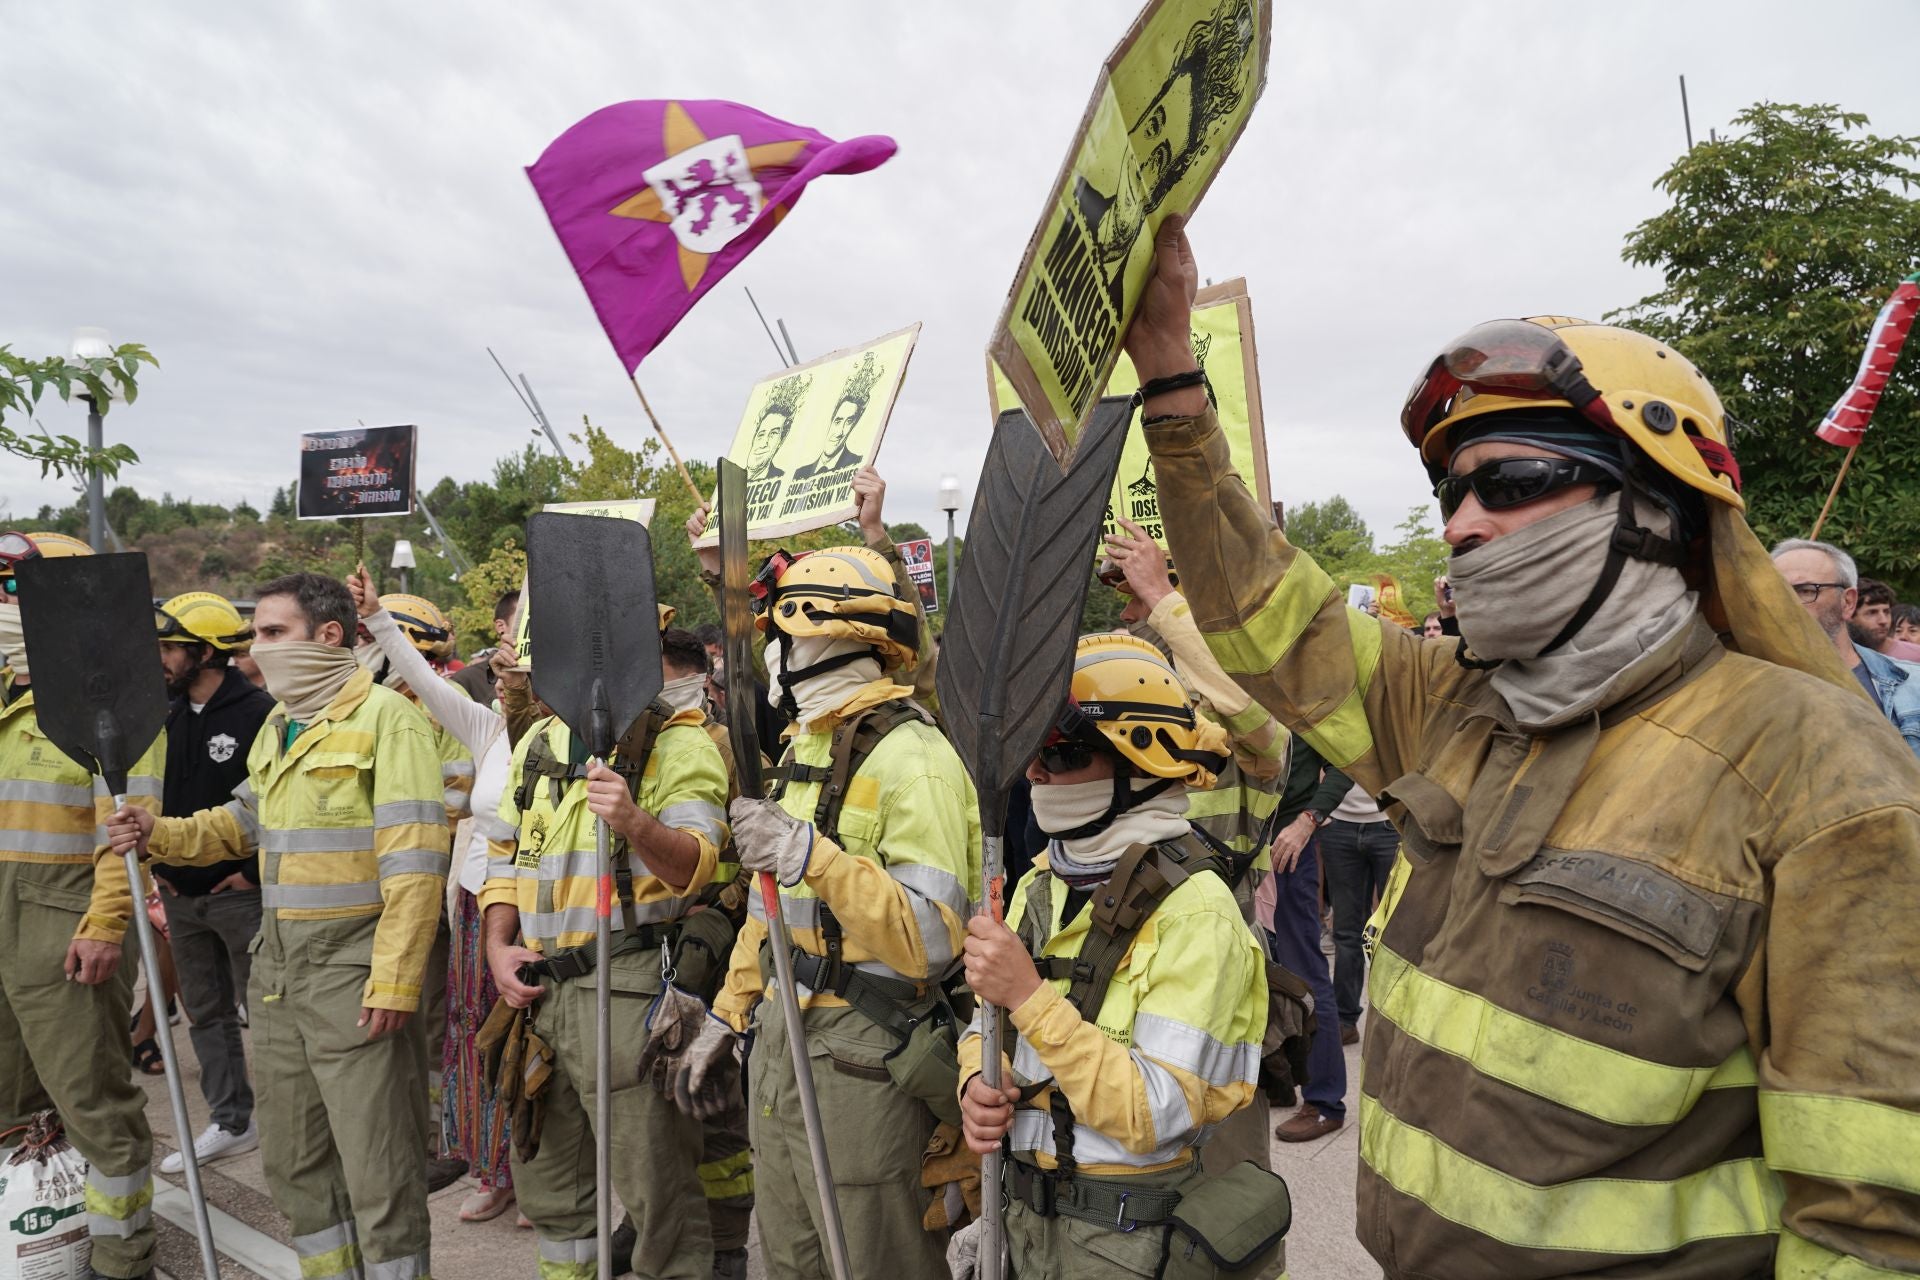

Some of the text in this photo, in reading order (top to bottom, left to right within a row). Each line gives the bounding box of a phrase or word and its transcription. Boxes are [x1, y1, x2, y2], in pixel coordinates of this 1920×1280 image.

[1132, 496, 1158, 517] JOSÉ
[908, 563, 930, 573] PABLES.
[1567, 985, 1638, 1017] Junta de
[22, 1212, 38, 1231] 15
[40, 1213, 53, 1228] KG
